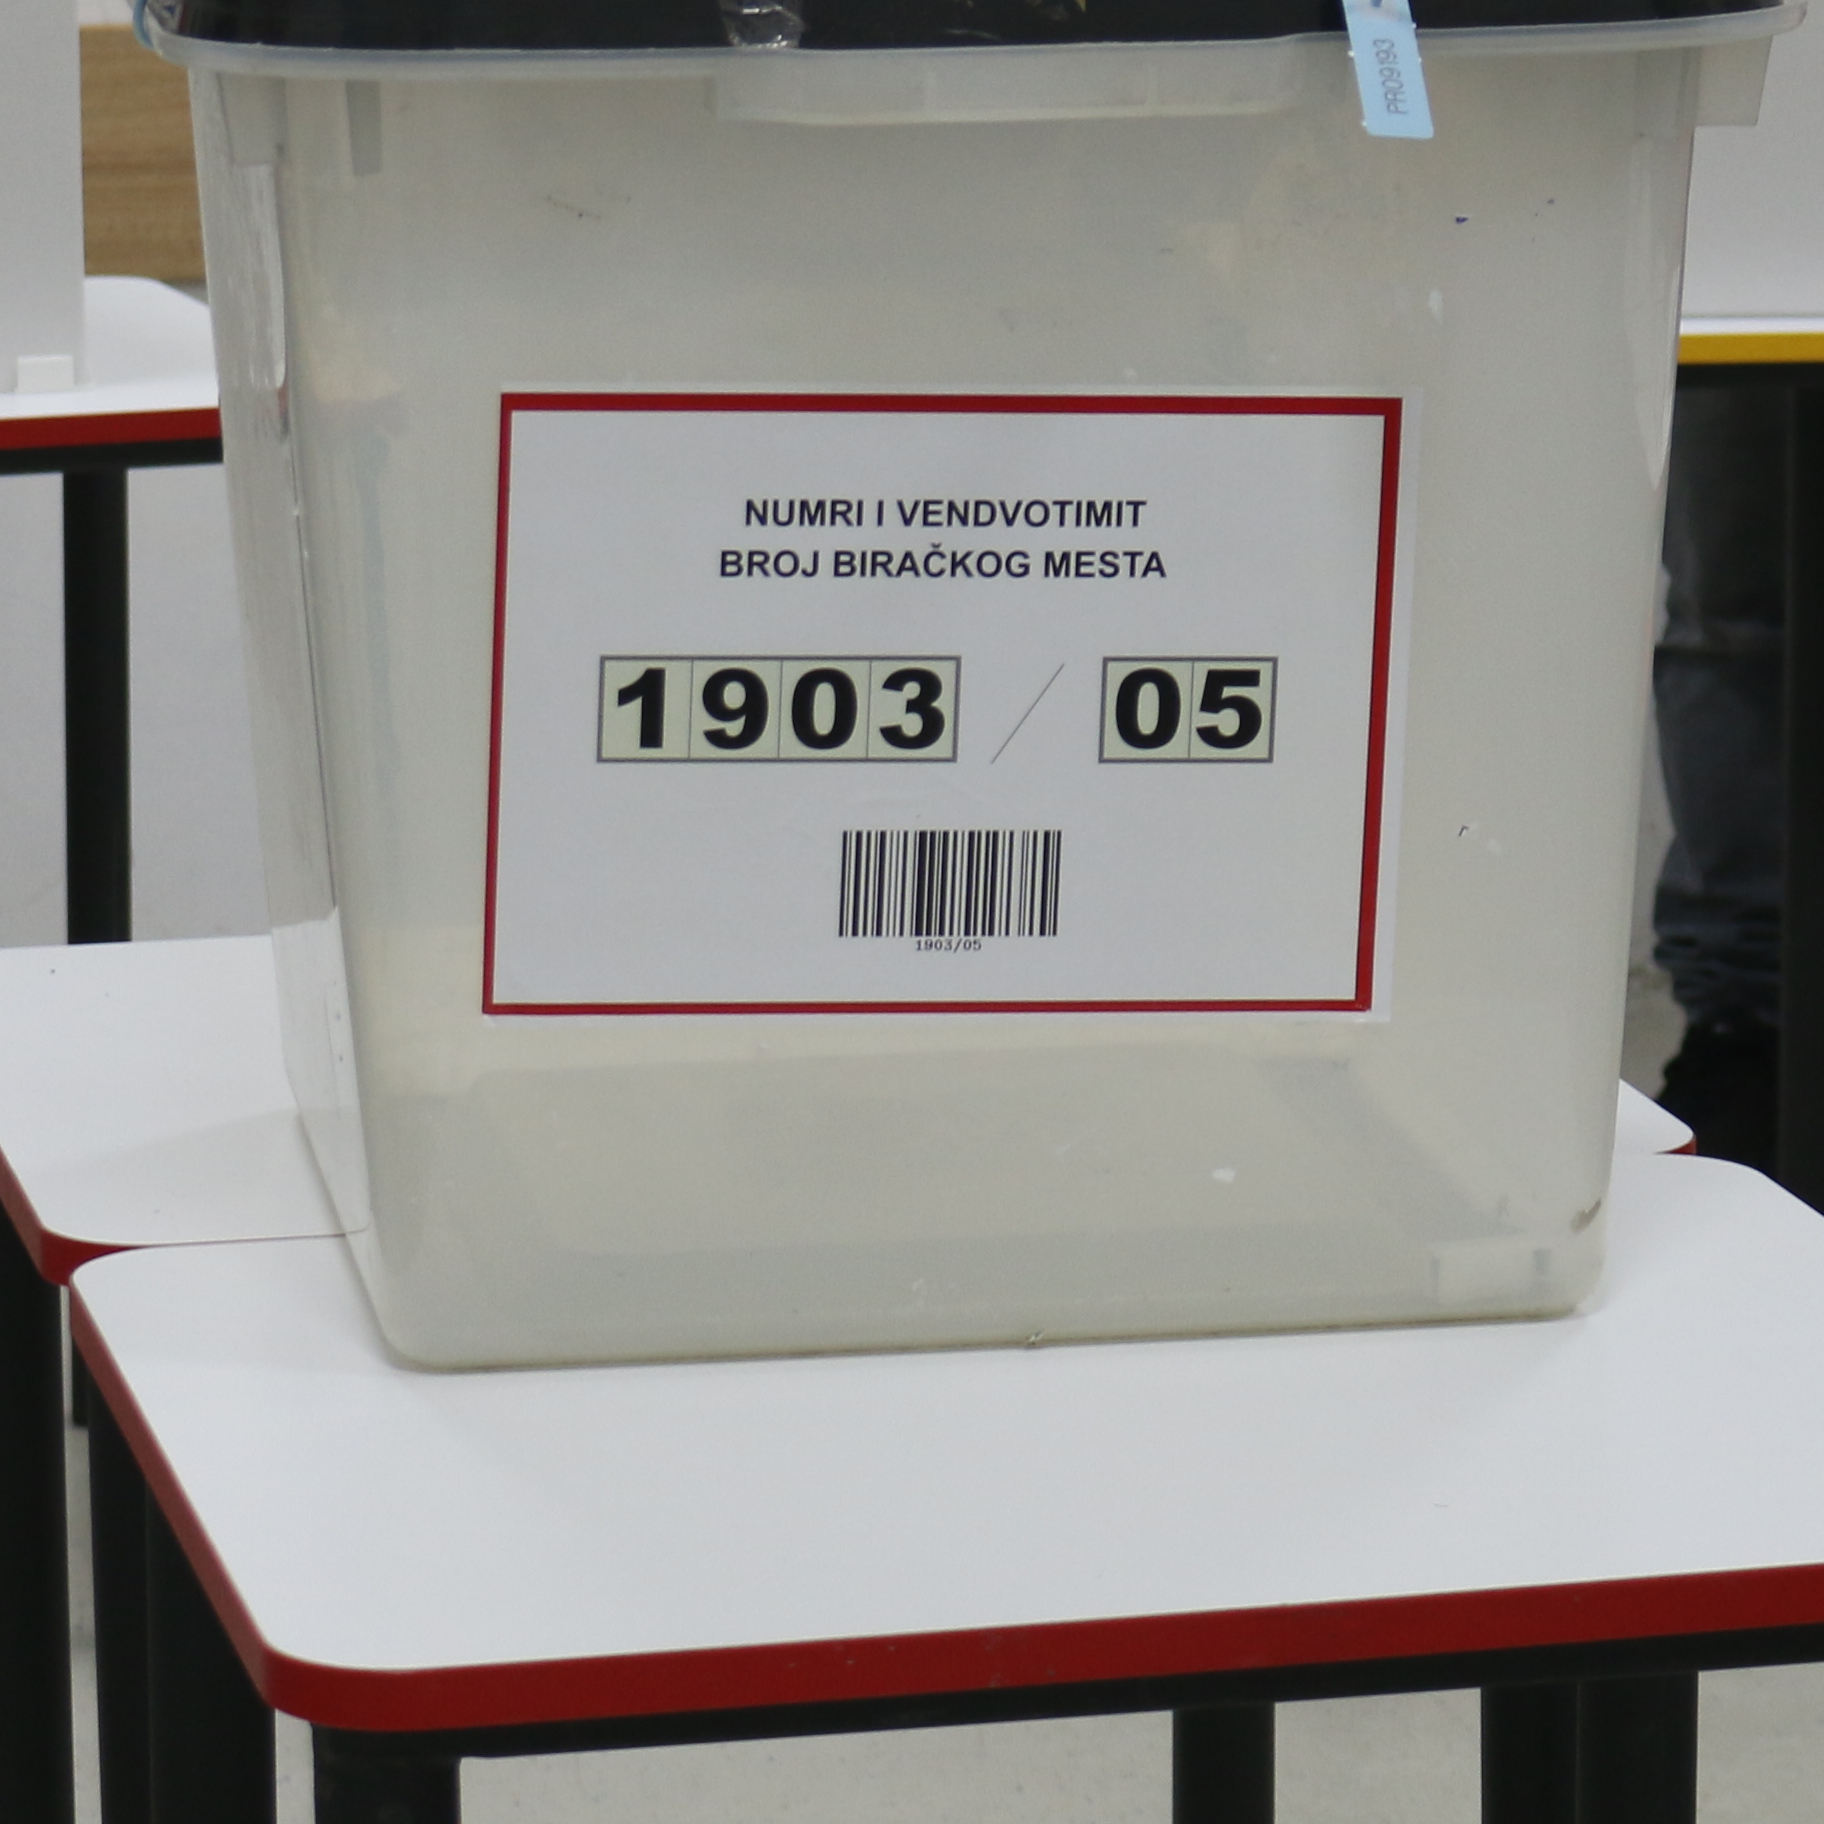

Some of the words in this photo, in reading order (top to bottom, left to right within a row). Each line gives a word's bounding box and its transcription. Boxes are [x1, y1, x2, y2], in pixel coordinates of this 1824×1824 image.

[744, 498, 865, 529] NUMRI
[876, 499, 885, 528] I
[896, 498, 1148, 529] VENDVOTIMIT
[718, 549, 820, 580] BROJ
[832, 542, 1032, 580] BIRAČKOG
[1043, 549, 1168, 580] MESTA
[616, 667, 946, 751] 1903
[1114, 667, 1264, 750] 05
[915, 938, 983, 954] 1903/05
